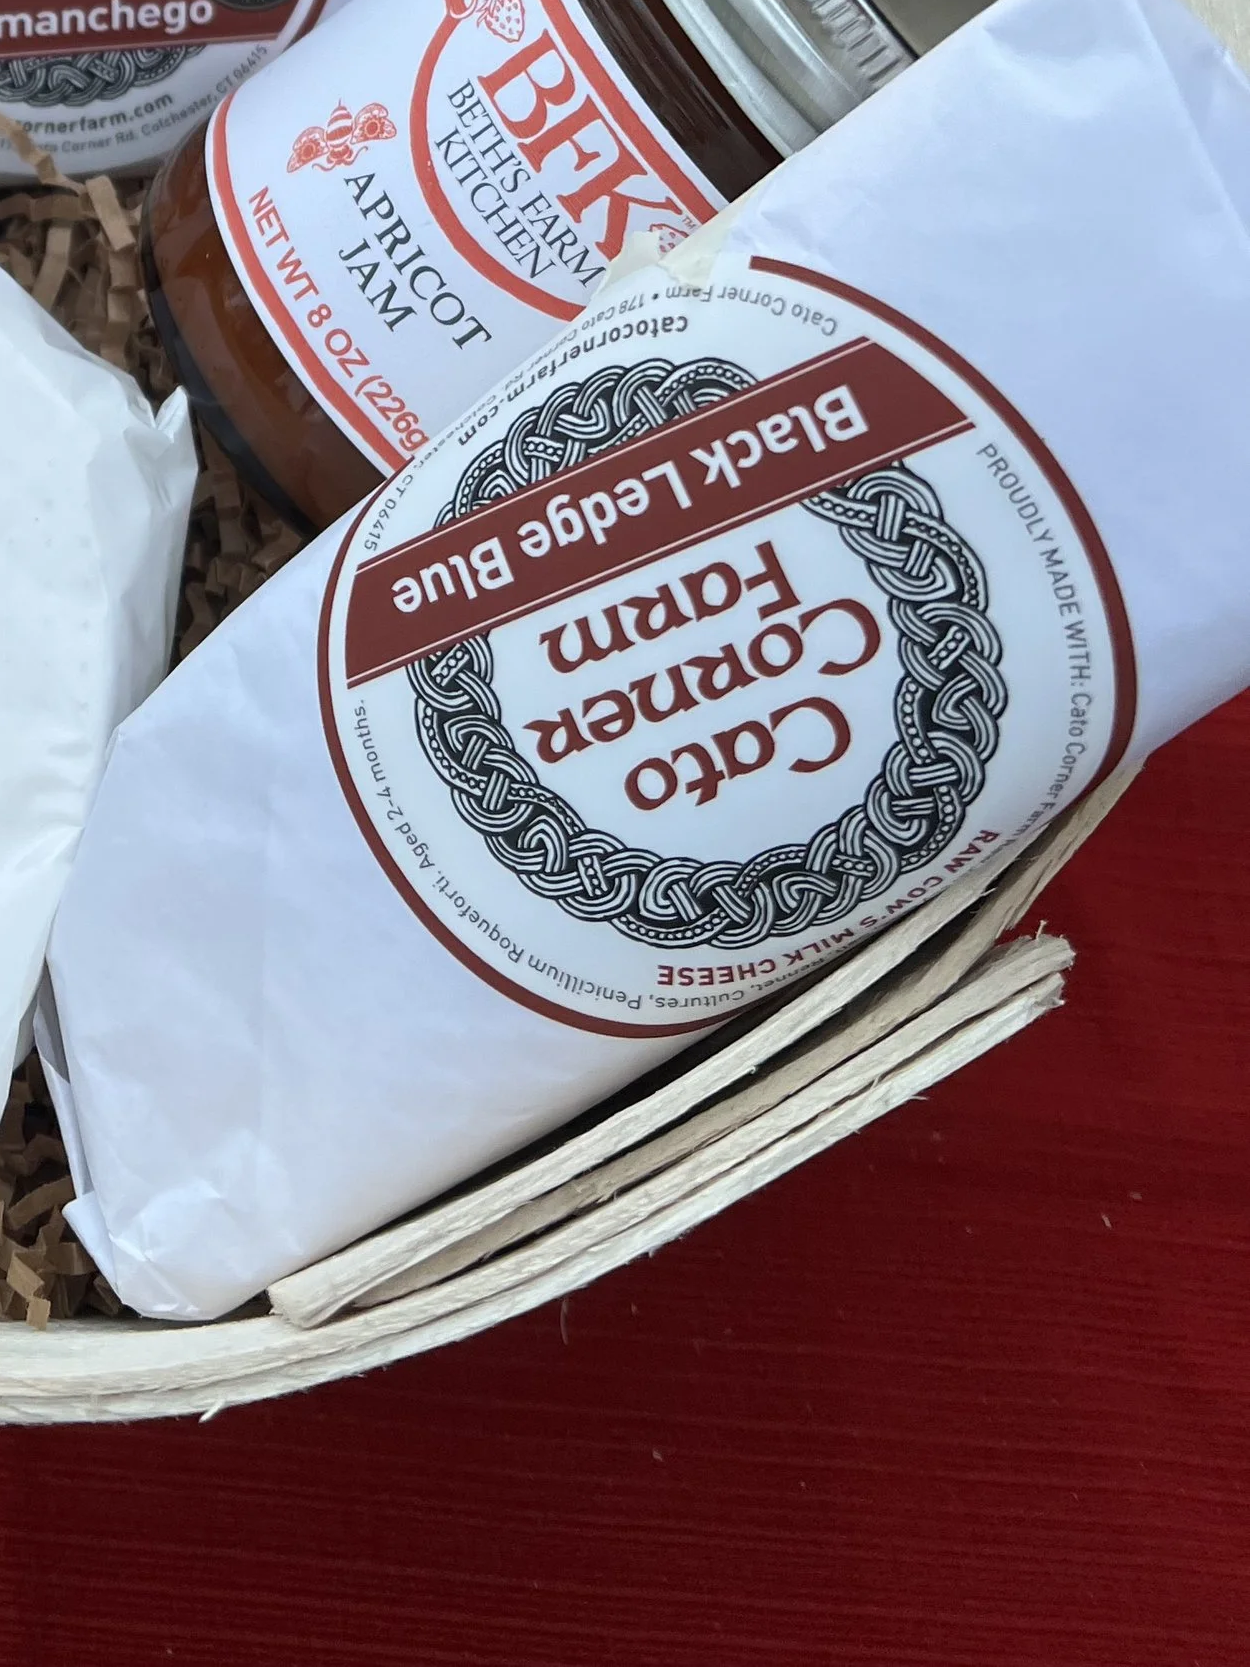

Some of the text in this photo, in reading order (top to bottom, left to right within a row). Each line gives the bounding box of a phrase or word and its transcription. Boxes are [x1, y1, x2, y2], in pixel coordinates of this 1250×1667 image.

[433, 125, 556, 281] KITCHEN
[446, 78, 605, 288] BETH'S FARM
[477, 28, 684, 262] BFK
[248, 186, 287, 244] NET
[279, 246, 318, 304] WT
[307, 304, 332, 329] 8
[324, 328, 370, 379] OZ
[338, 242, 418, 333] JAM
[343, 171, 492, 352] APRICOT
[363, 284, 839, 552] Cato Corner Farm 178 Cato 06415
[458, 315, 689, 447] catocornerfarm.com
[390, 385, 871, 615] Black Ledge Blue
[538, 540, 802, 675] Farm
[975, 442, 1093, 799] PROUDLY MADE WITH: Cato Corner
[354, 699, 386, 783] months.
[523, 598, 882, 764] Corner
[377, 786, 404, 821] 2-4
[624, 696, 852, 811] Cato
[394, 821, 435, 870] Aged
[945, 829, 1001, 874] RAW
[528, 957, 642, 1011] Penicillium
[649, 989, 746, 1009] Cultures,
[657, 958, 776, 987] CHEESE
[783, 928, 855, 966] MILK
